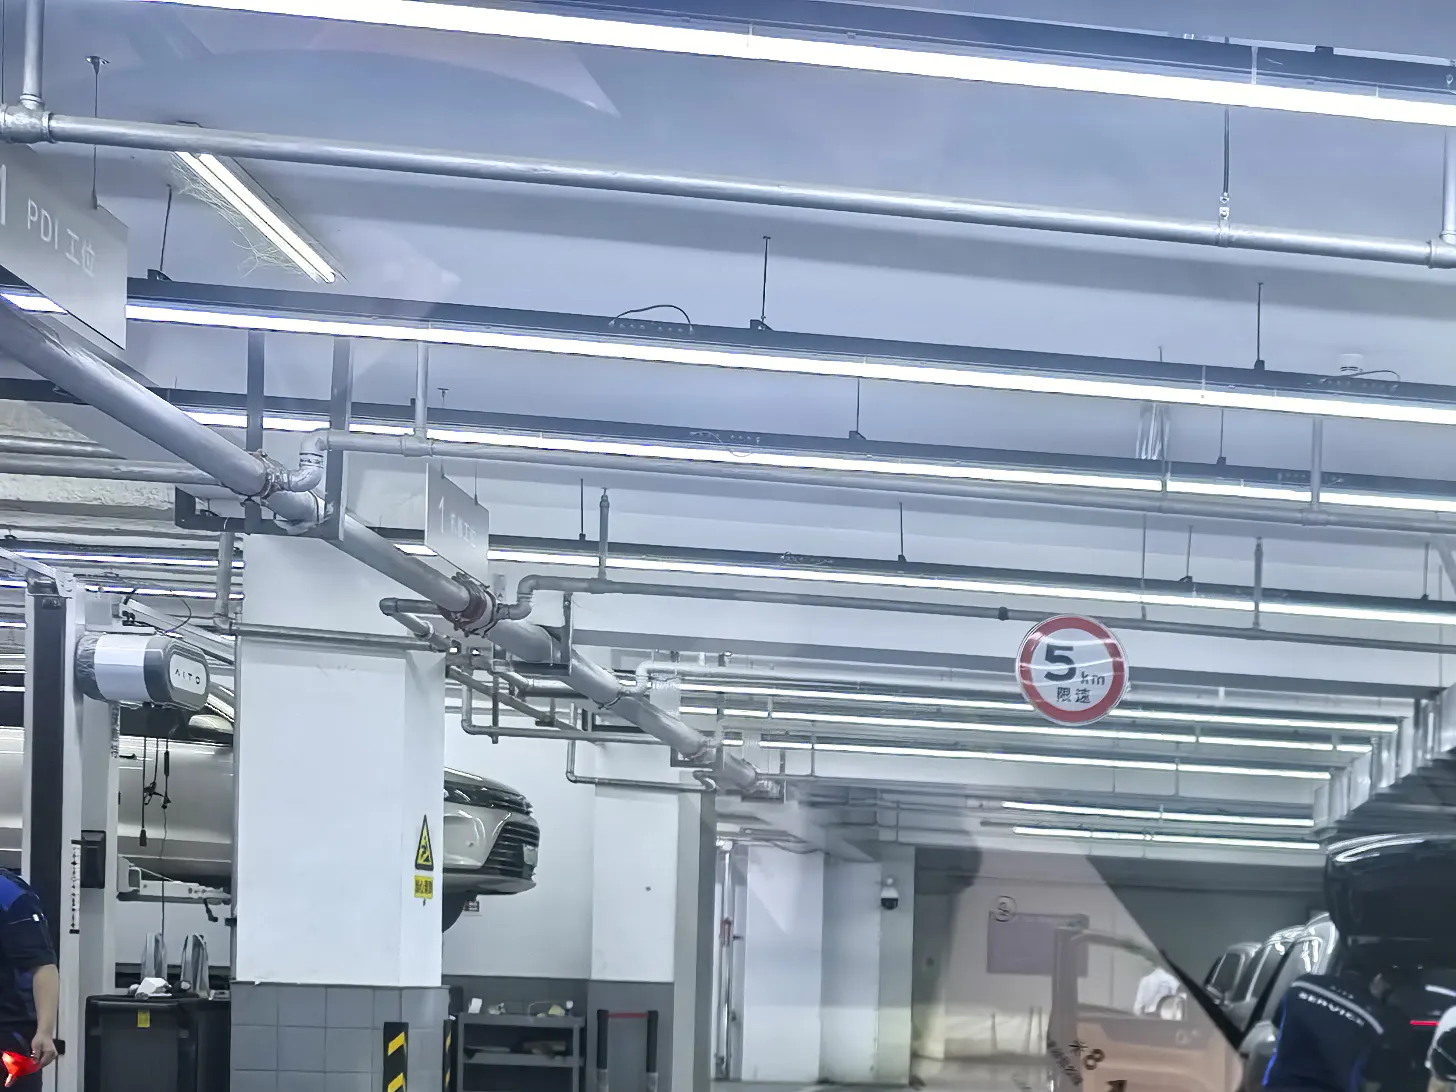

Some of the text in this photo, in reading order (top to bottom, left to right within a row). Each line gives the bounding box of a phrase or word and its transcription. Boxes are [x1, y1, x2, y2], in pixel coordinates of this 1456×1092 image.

[27, 198, 59, 250] PDI
[65, 228, 96, 278] 工位
[174, 668, 201, 685] AITO
[1056, 686, 1092, 704] 限速
